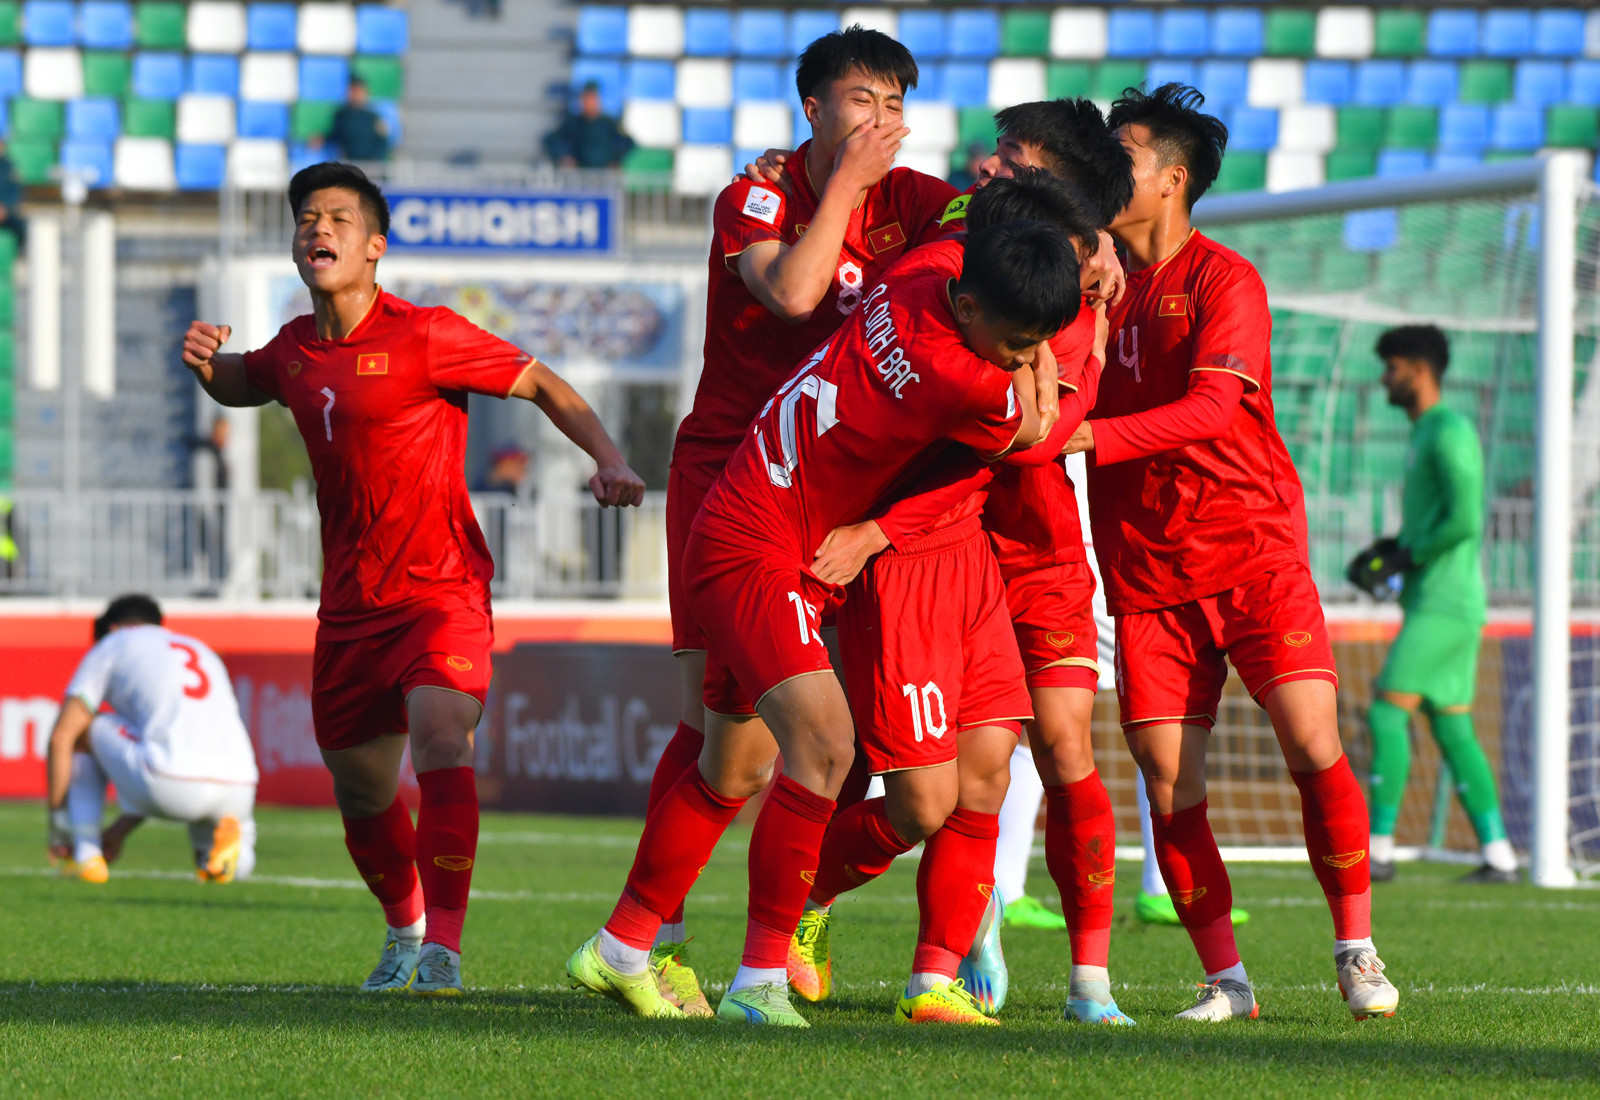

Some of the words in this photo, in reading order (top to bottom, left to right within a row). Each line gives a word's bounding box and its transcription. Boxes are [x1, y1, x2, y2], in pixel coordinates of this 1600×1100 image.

[392, 198, 598, 245] CHIQISH
[836, 261, 863, 316] 8
[876, 346, 920, 400] BAC
[1118, 325, 1142, 383] 4
[320, 386, 336, 442] 7
[169, 641, 211, 700] 3
[504, 691, 622, 781] Football
[902, 680, 948, 742] 10
